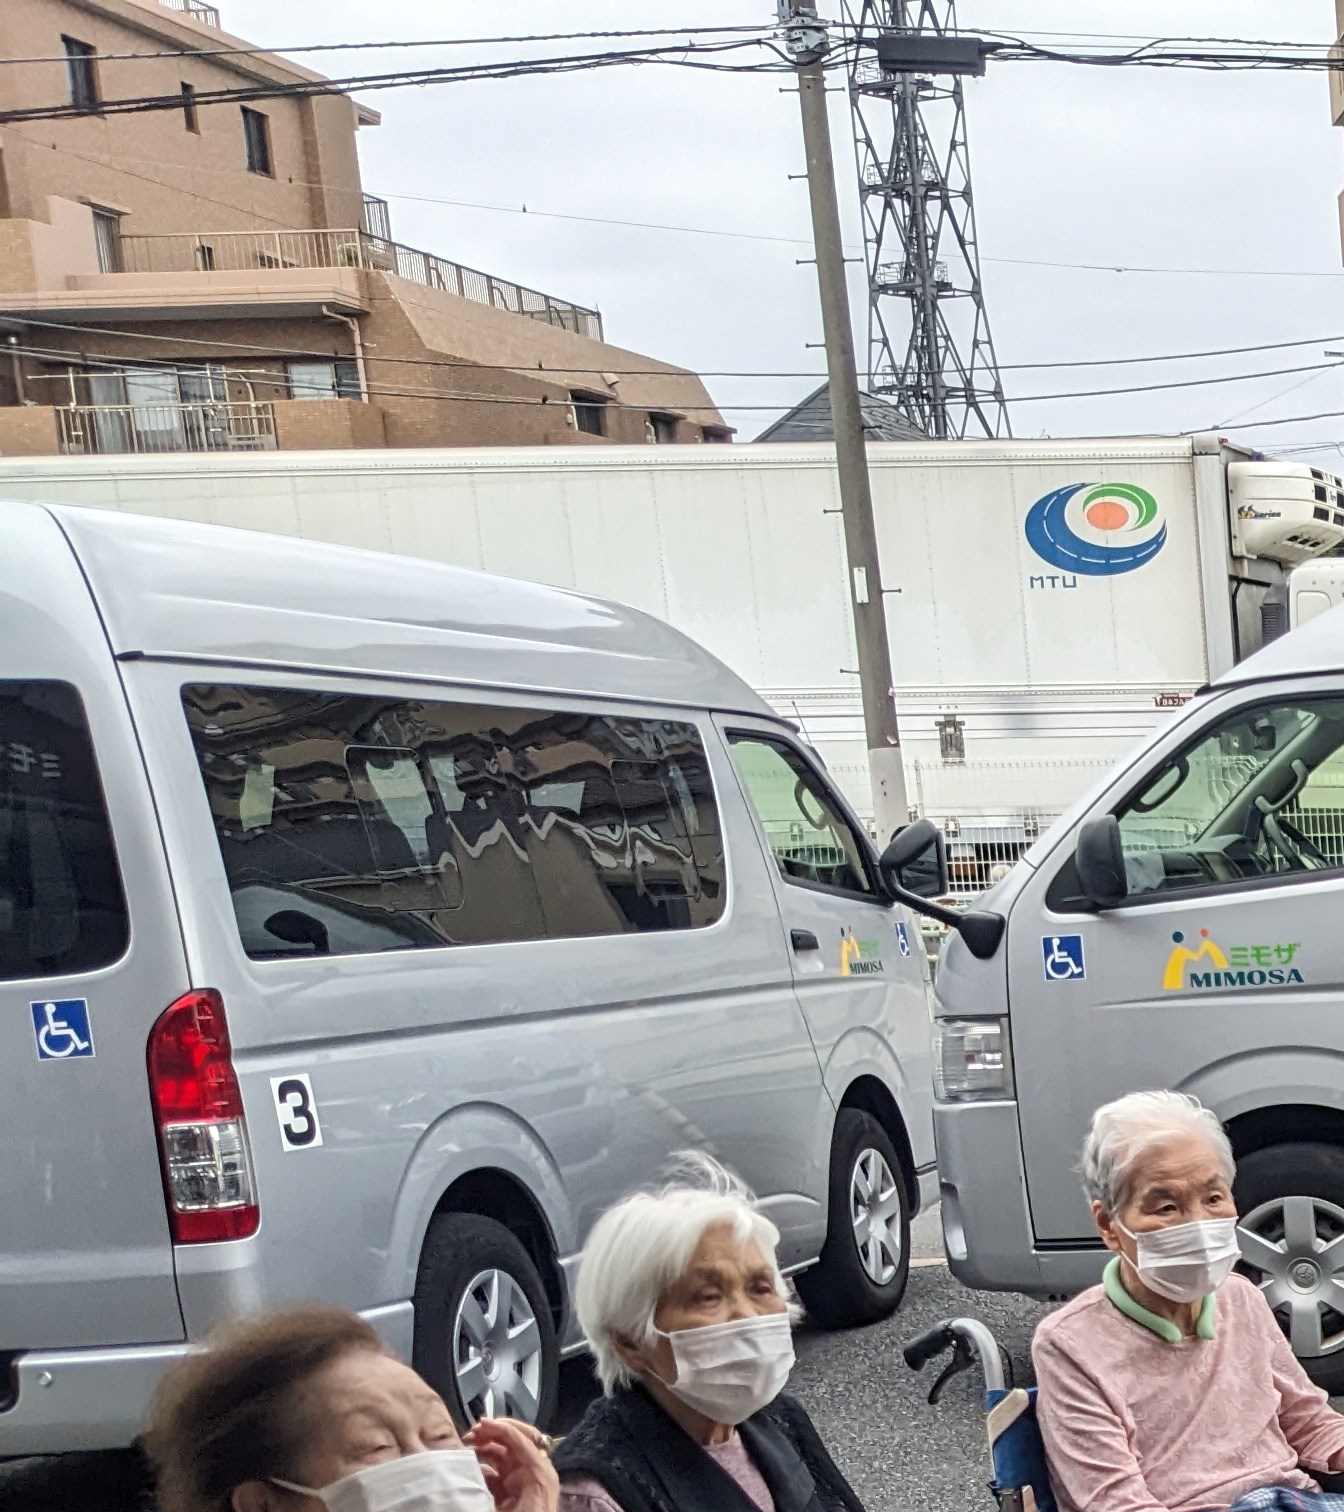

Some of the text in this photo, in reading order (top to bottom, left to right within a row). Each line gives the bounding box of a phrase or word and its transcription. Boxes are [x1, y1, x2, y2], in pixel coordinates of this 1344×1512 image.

[1030, 576, 1077, 589] MTU
[1231, 942, 1301, 967] ミモザ
[1190, 968, 1305, 988] MIMOSA
[278, 1079, 317, 1147] 3
